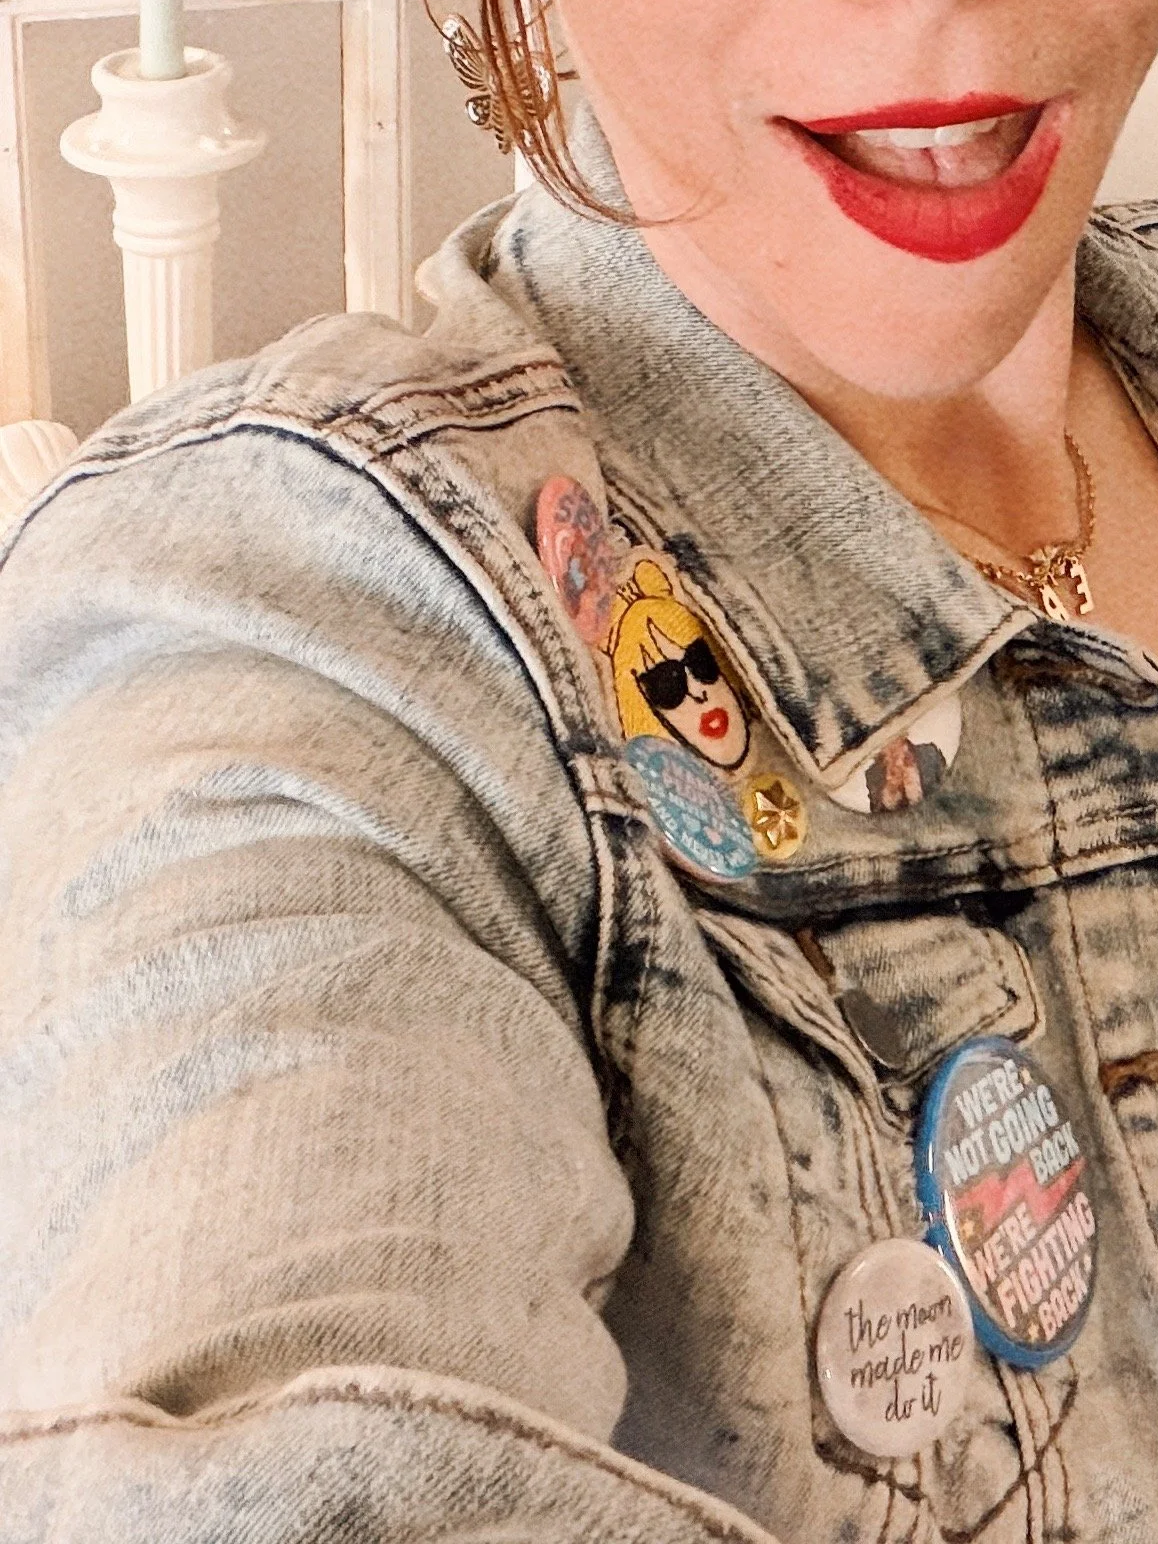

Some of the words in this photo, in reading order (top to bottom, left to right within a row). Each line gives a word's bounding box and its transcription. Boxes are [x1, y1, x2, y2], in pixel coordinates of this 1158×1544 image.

[955, 1058, 1025, 1129] WE'RE
[944, 1127, 989, 1186] NOT
[989, 1084, 1060, 1165] GOING
[1029, 1120, 1080, 1186] BACK
[997, 1191, 1096, 1329] FIGHTING
[843, 1299, 892, 1354] the
[895, 1294, 952, 1330] moon
[850, 1329, 925, 1389] made
[928, 1335, 965, 1363] me
[885, 1377, 918, 1423] do
[921, 1371, 942, 1417] it
